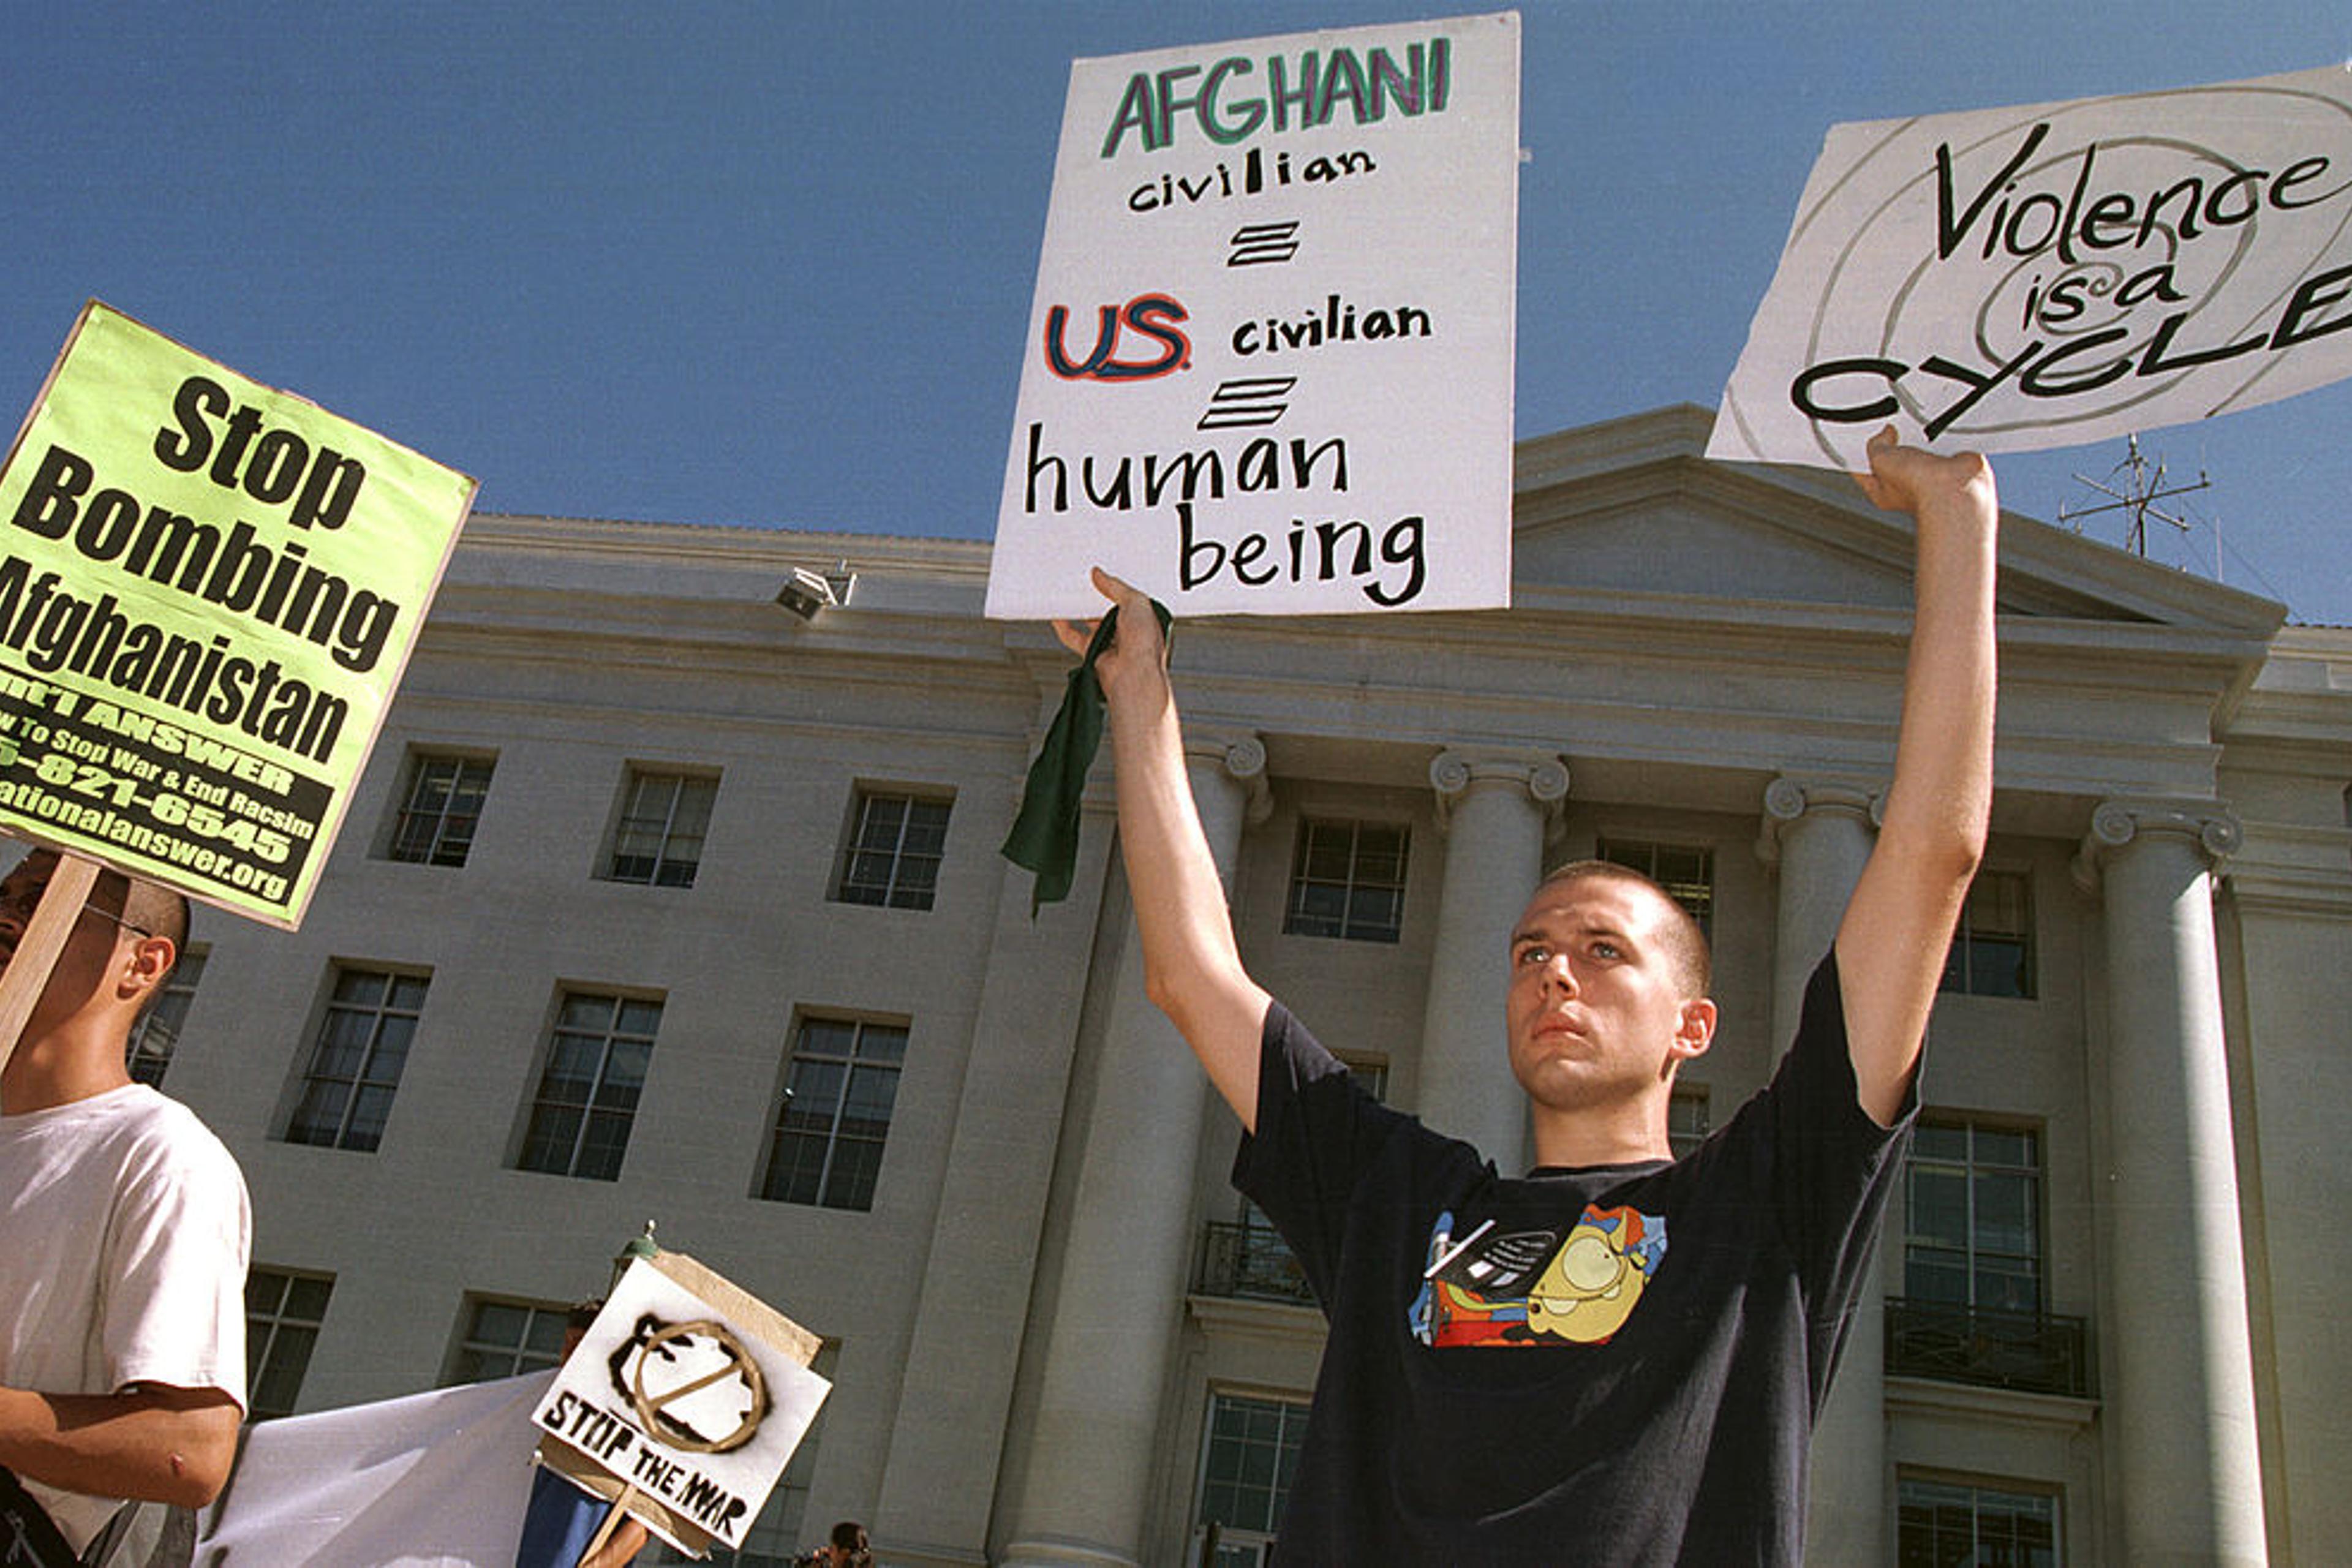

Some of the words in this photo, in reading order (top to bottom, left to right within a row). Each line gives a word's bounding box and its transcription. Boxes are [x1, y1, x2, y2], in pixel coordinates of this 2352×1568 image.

[1101, 38, 1450, 158] AFGHANI
[1129, 148, 1376, 213] civilian
[1935, 123, 2352, 263] Violence
[1232, 295, 1432, 355] civilian
[2023, 275, 2087, 331] is
[2114, 264, 2188, 309] a
[1790, 265, 2352, 443] CYCLE
[154, 375, 366, 531] Stop
[1025, 423, 1348, 513] human
[10, 444, 400, 673] Bombing
[1176, 502, 1426, 606] being
[0, 556, 349, 764] Afghanistan
[20, 717, 50, 744] To
[51, 729, 110, 763] Stop
[111, 748, 162, 781] War
[162, 771, 180, 790] &
[184, 774, 229, 806] End
[82, 701, 295, 796] ANSWER
[543, 1391, 635, 1461] STOP
[633, 1447, 685, 1496] THE
[676, 1472, 748, 1540] WAR
